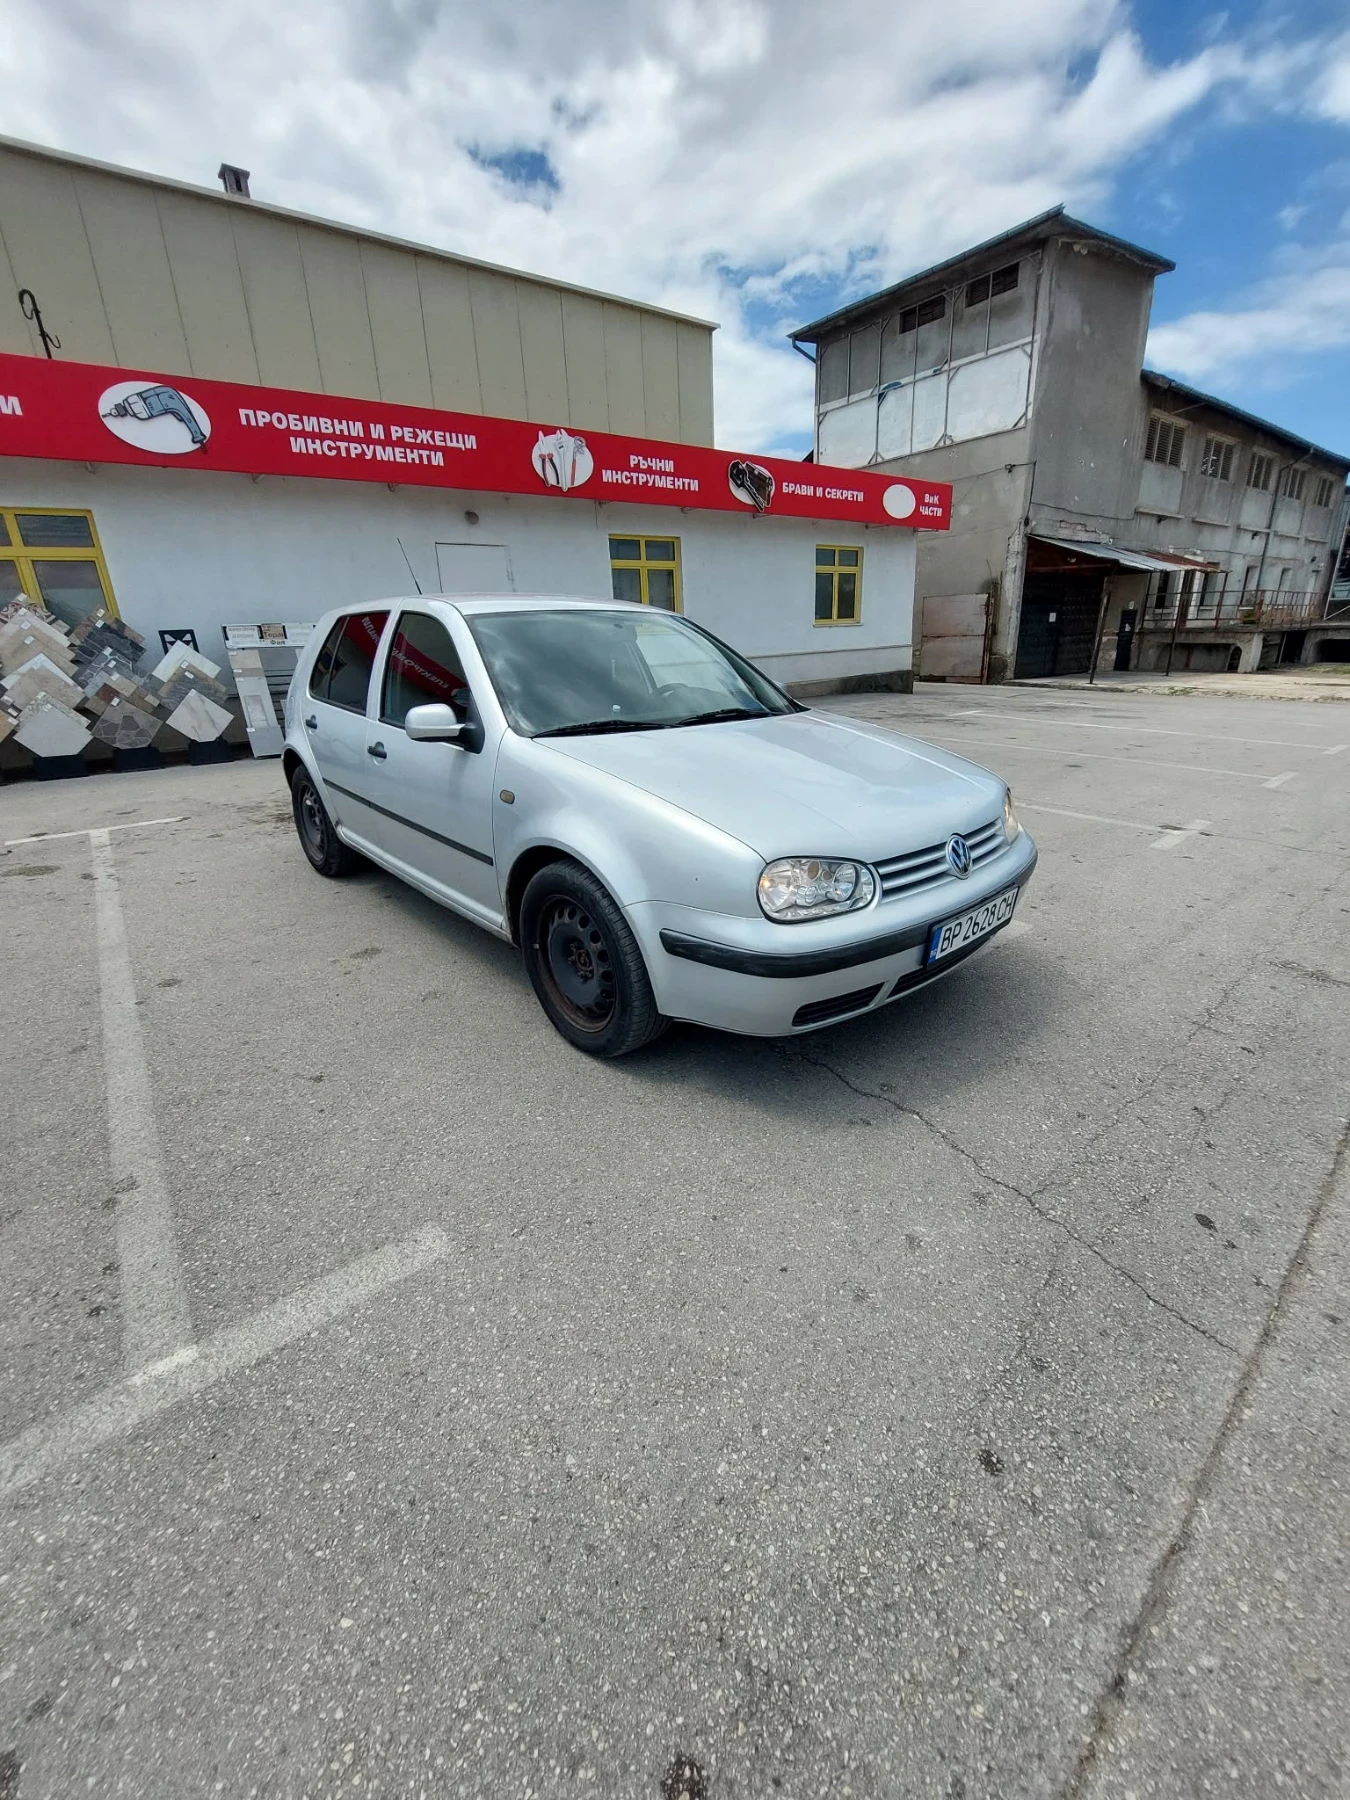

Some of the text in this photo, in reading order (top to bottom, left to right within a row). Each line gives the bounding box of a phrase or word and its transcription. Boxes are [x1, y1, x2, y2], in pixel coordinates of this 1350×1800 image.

[238, 408, 477, 451] ПРОБИВНИ И РЕЖЕЩИ
[289, 436, 445, 467] ИНСТРУМЕНТИ
[629, 454, 674, 473] РЪЧНИ
[601, 469, 699, 492] ИНСТРУМЕНТИ
[782, 482, 864, 502] БРАВИ И СЕКРЕТИ
[924, 493, 939, 505] ВиК
[919, 505, 943, 517] ЧАСТИ
[940, 891, 1016, 953] BP 2628 CH
